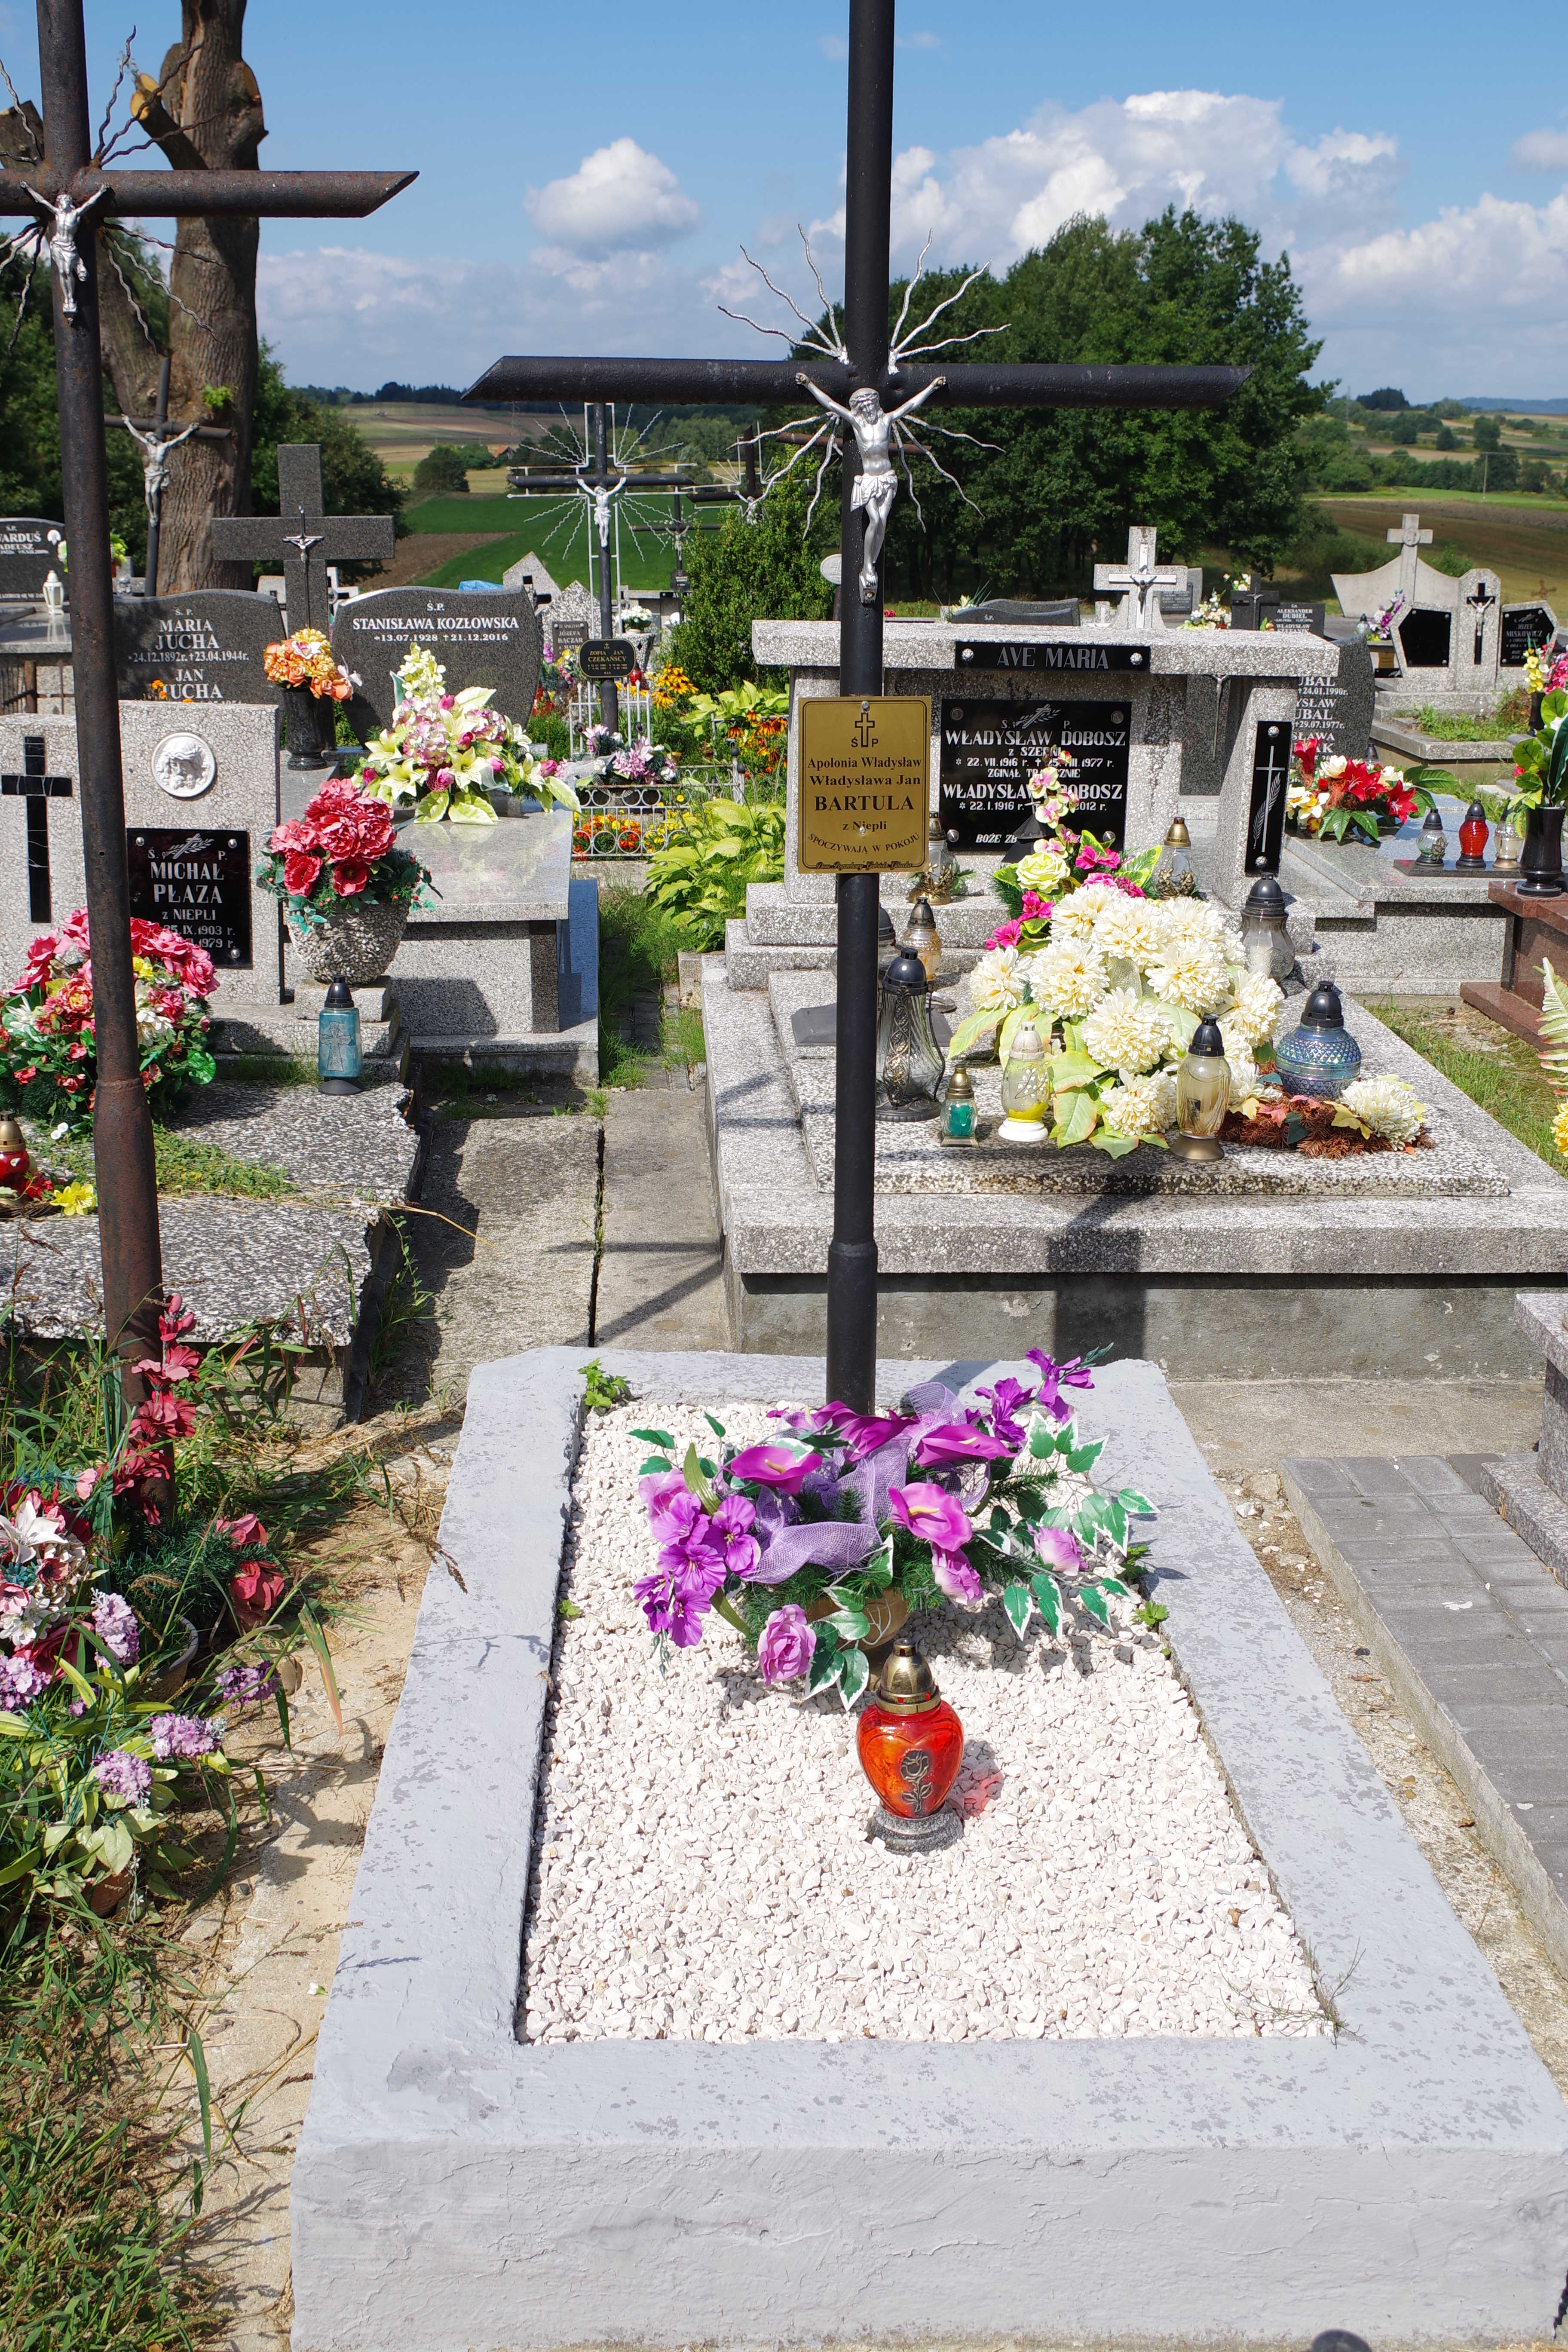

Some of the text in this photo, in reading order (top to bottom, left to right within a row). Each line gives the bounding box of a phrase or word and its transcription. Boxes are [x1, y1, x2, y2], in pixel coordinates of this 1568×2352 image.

[0, 531, 42, 543] ARDUŚ
[427, 600, 444, 611] Ś.P.
[159, 619, 213, 632] MARIA
[353, 617, 519, 630] STANISŁAWA KOZŁOWSKA
[155, 634, 220, 650] JUCHA
[997, 646, 1109, 669] AVE MARIA
[175, 669, 204, 682] JAN
[851, 737, 879, 748] Ś P
[945, 730, 1126, 746] WŁADYSŁAW DOBOSZ
[808, 756, 922, 771] Apolonia Władysław
[988, 769, 1021, 779] ZGINĄŁ
[809, 775, 921, 788] Władysława Jan
[815, 795, 915, 811] BARTULA
[853, 821, 887, 833] Niepli
[808, 833, 868, 854] SPOCZYWAJĄ
[885, 832, 920, 851] POKOJU
[975, 832, 1002, 843] BOŻE
[218, 850, 227, 861] P.
[151, 861, 224, 880] MICHAŁ
[153, 884, 223, 903] PŁAZA
[162, 909, 216, 920] z NIEPLI
[227, 927, 236, 935] r.
[227, 940, 236, 949] r.
